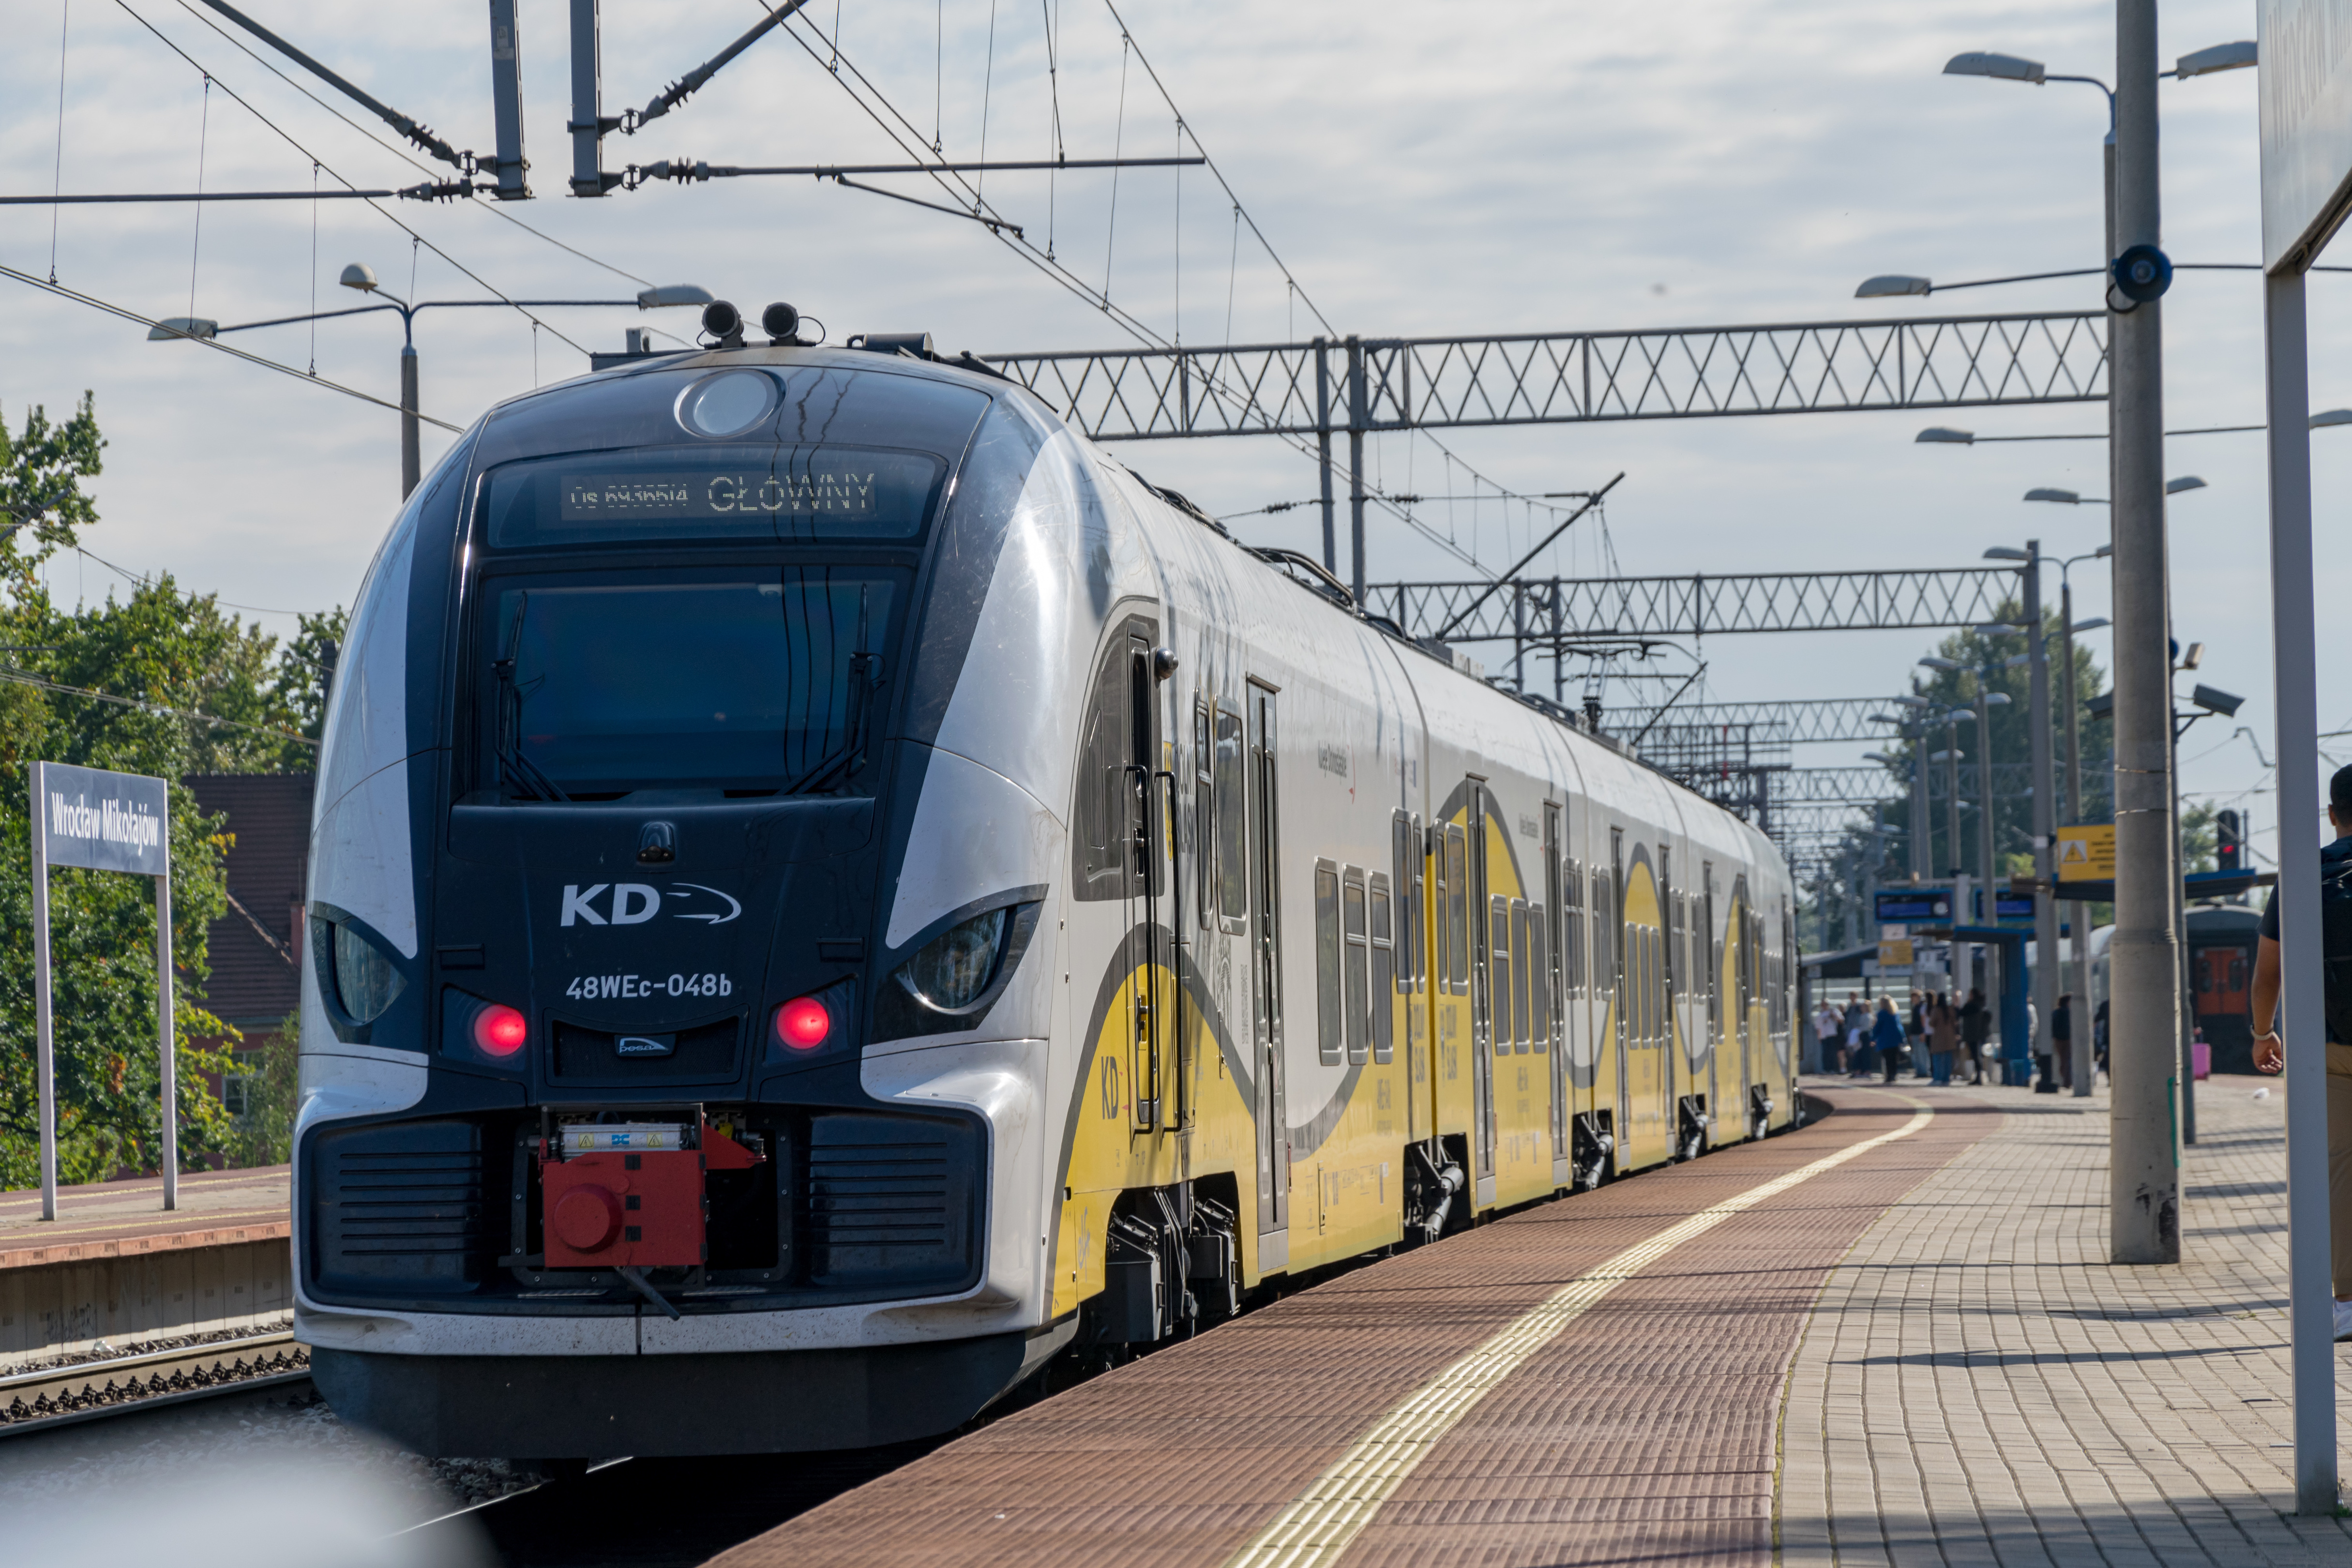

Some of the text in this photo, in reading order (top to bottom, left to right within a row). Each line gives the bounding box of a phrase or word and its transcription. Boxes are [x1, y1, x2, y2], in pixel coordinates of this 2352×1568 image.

[707, 472, 875, 512] GŁÓWNY
[1175, 743, 1195, 796] DOLNY
[51, 792, 158, 857] Wrocław Mikołajów
[560, 883, 661, 927] KD
[566, 973, 732, 1000] 48WEc-048b
[1101, 1055, 1118, 1120] KD
